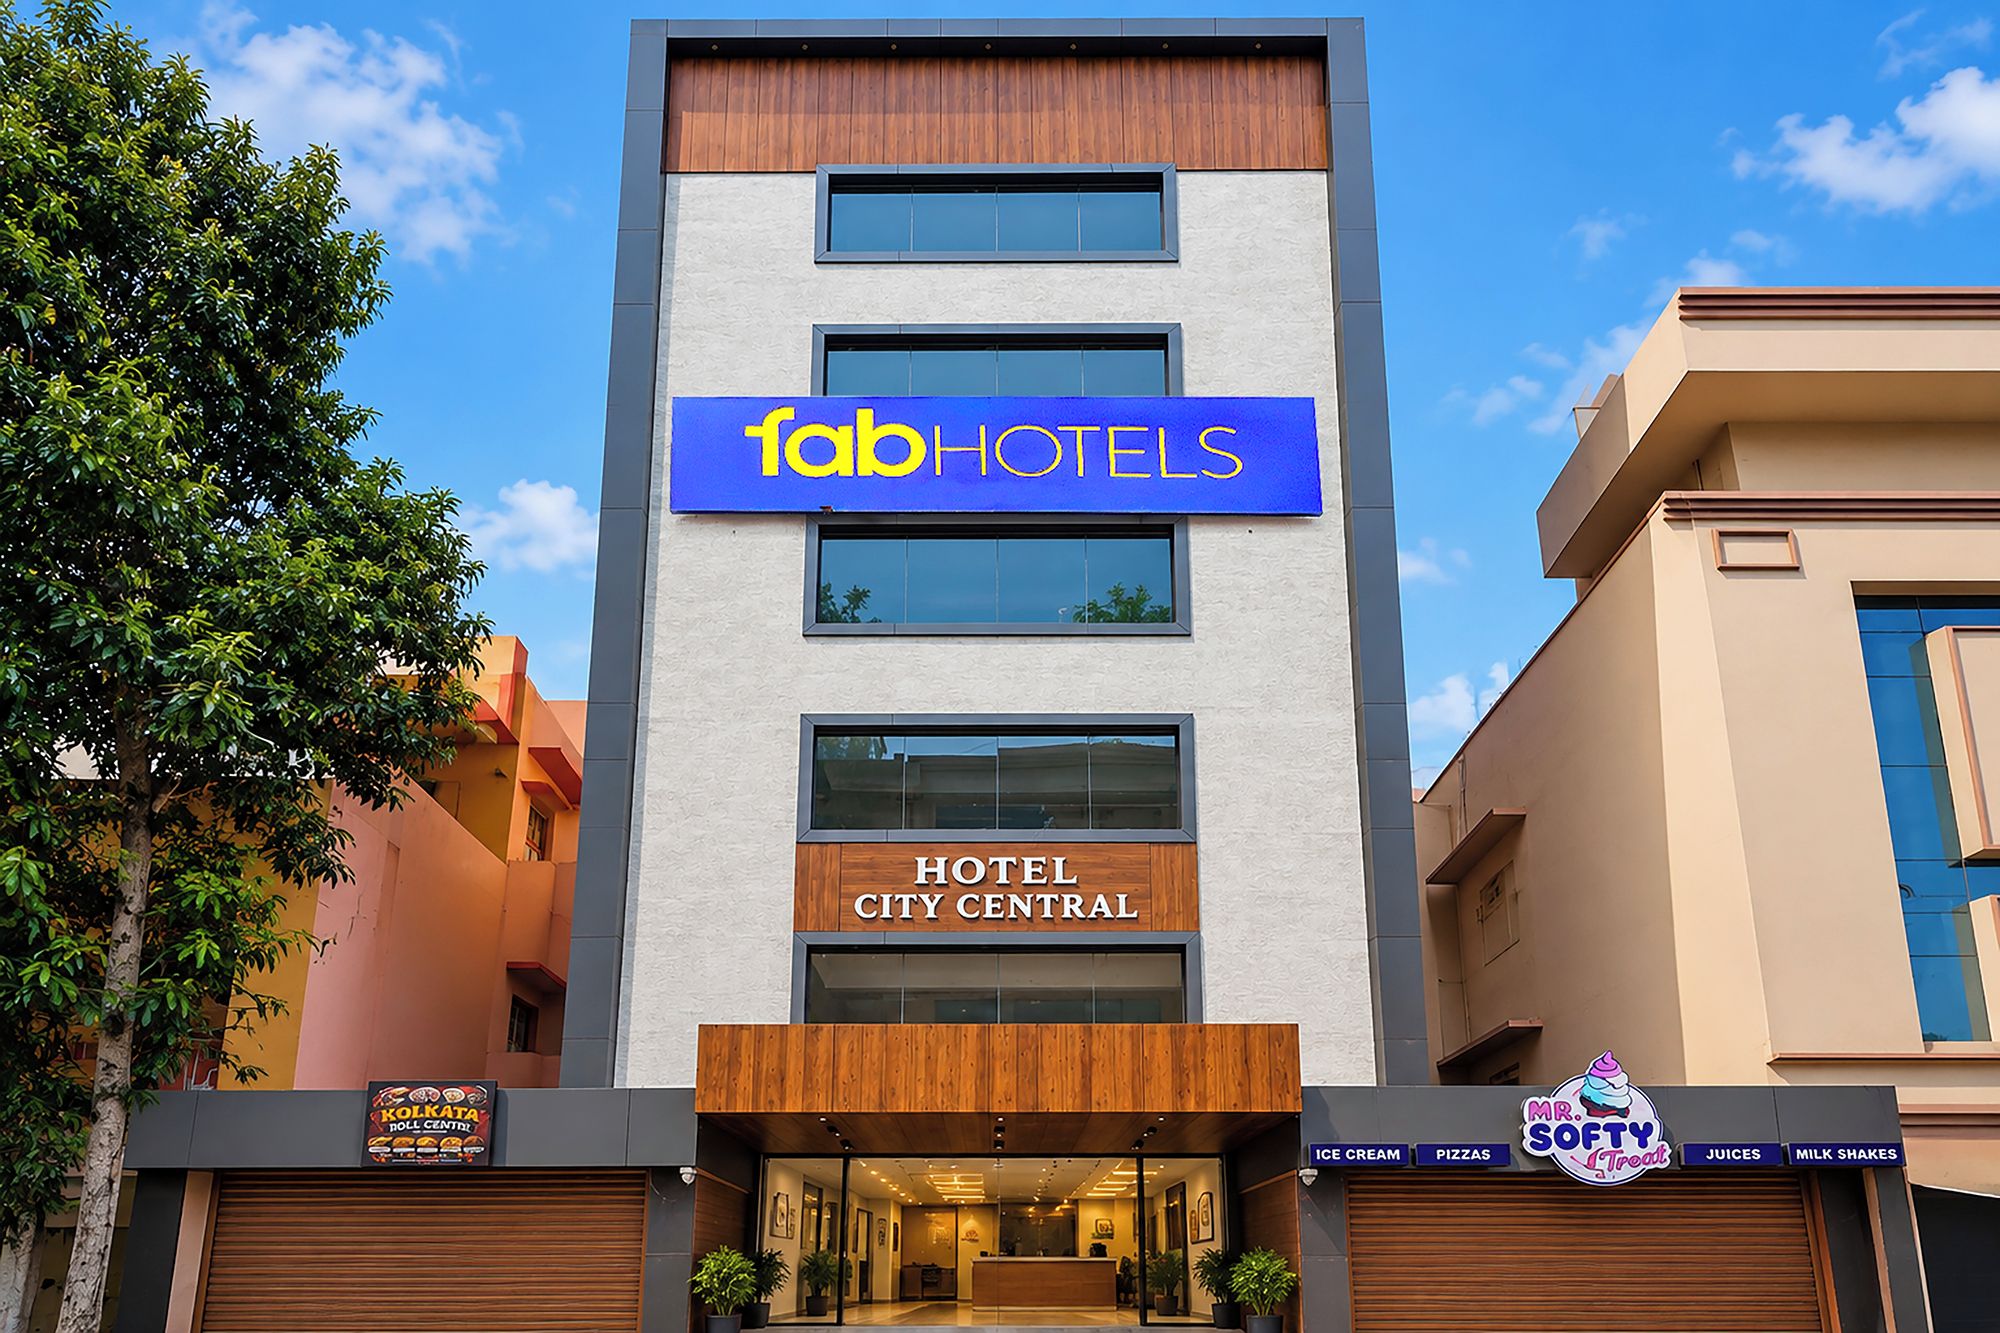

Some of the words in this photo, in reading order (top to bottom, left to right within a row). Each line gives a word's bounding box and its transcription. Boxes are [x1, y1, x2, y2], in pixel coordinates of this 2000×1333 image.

[914, 856, 1078, 885] HOTEL
[854, 893, 945, 919] CITY
[956, 893, 1139, 919] CENTRAL
[381, 1104, 480, 1124] KOLKATA
[1528, 1100, 1582, 1121] MR.
[1529, 1121, 1654, 1151] SOFTY
[1316, 1149, 1341, 1160] ICE
[1345, 1149, 1401, 1160] CREAM
[1436, 1149, 1491, 1160] PIZZAS
[1599, 1144, 1668, 1172] Treat
[1706, 1148, 1762, 1160] JUICES
[1796, 1148, 1833, 1160] MILK
[1837, 1148, 1898, 1160] SHAKES
